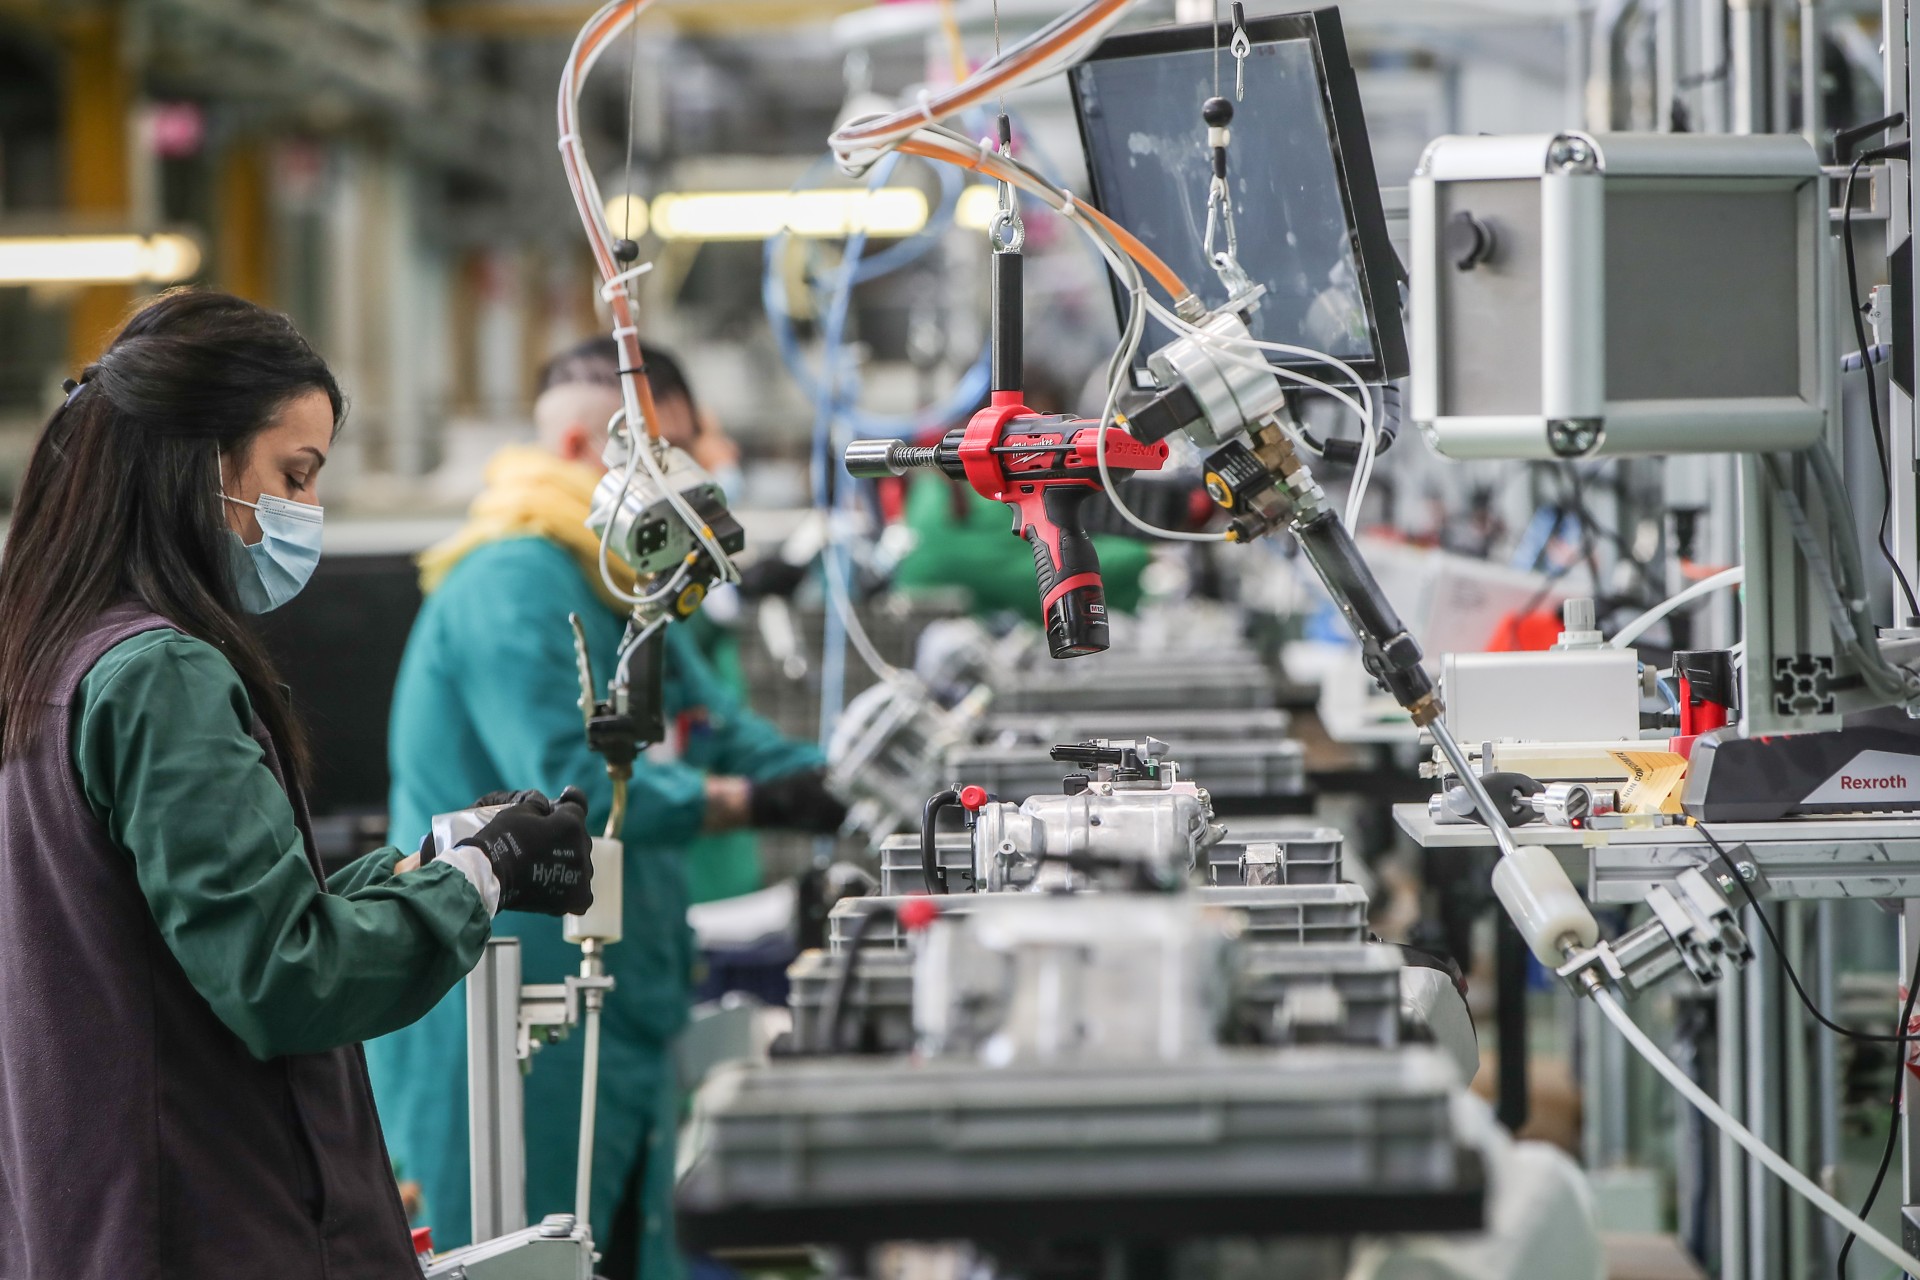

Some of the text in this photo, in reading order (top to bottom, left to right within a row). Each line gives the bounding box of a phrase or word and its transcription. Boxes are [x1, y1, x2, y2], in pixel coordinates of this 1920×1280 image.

[1115, 442, 1156, 457] STERN
[1091, 605, 1104, 613] M12
[1623, 782, 1637, 798] NON
[1841, 774, 1907, 790] Rexroth
[532, 863, 582, 887] HyFlex
